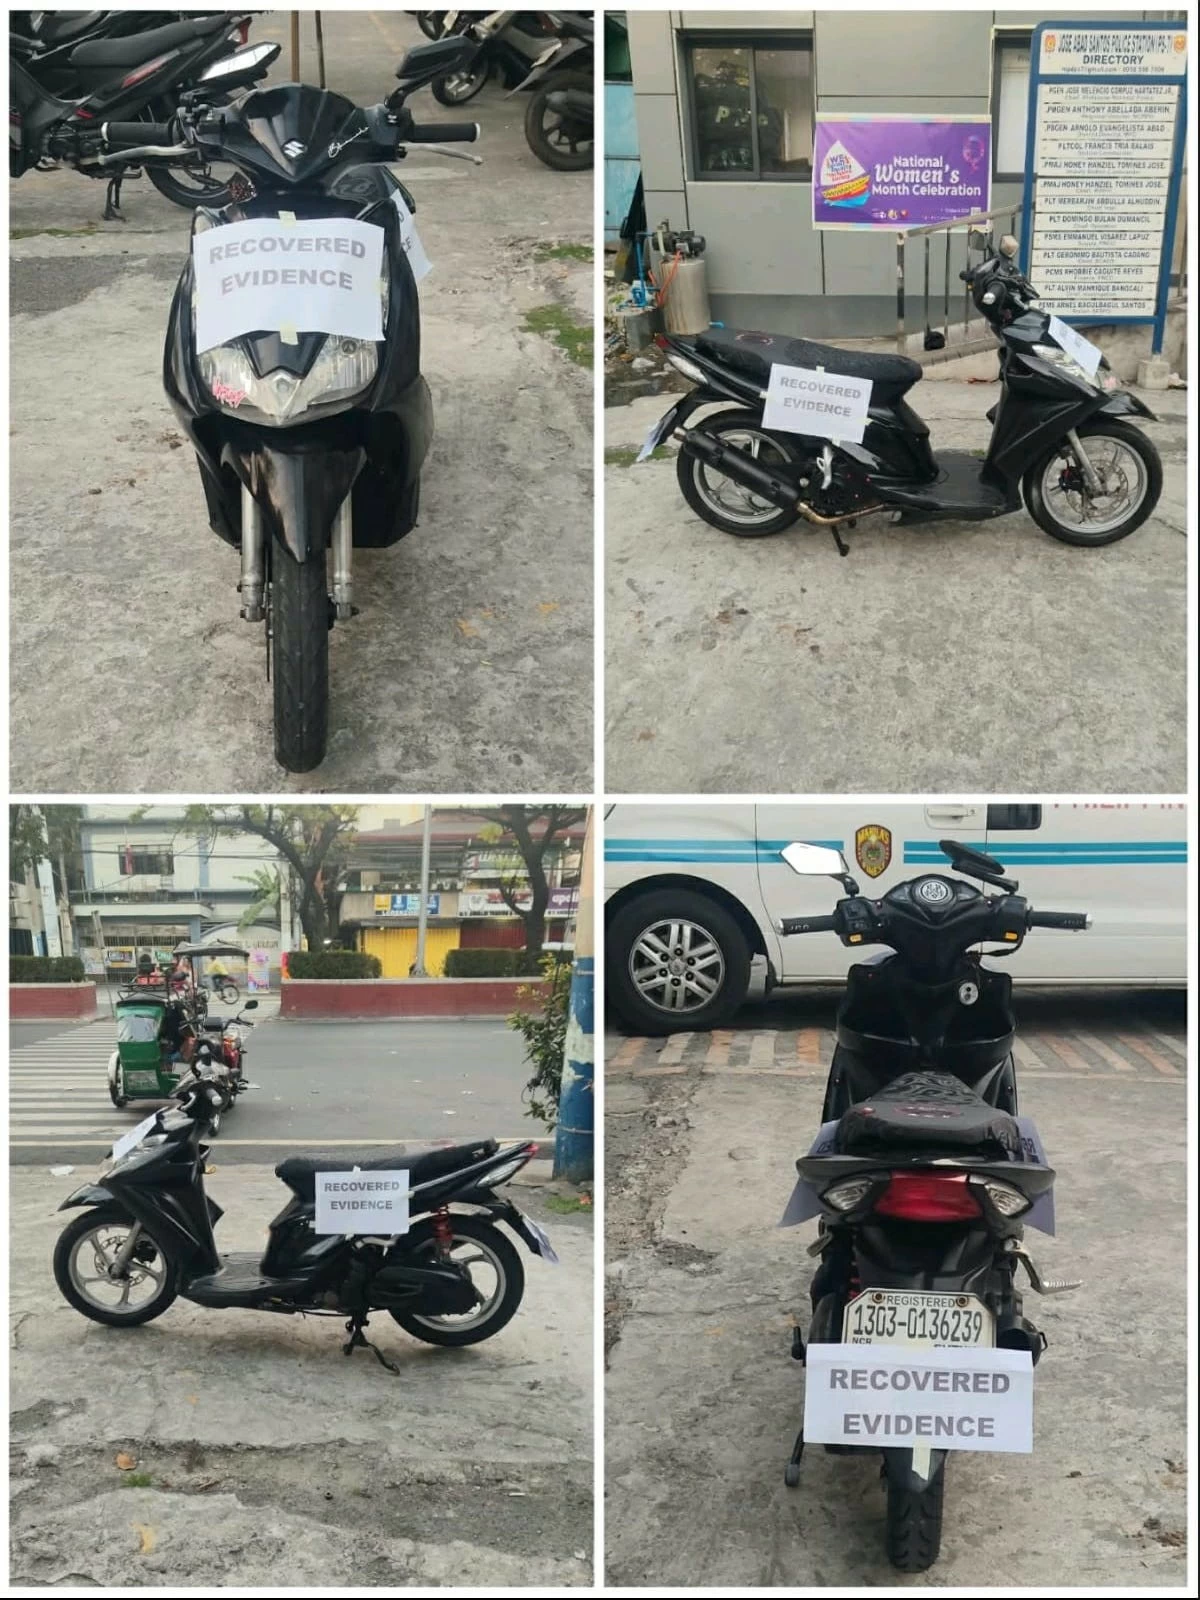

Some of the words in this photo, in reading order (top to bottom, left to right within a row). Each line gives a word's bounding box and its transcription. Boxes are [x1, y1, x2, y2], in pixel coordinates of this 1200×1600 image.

[1058, 35, 1072, 53] JOSE
[1073, 35, 1087, 53] ABAD
[1089, 35, 1110, 53] SANTOS
[1112, 35, 1130, 53] POLICE
[1083, 55, 1144, 64] DIRECTORY
[1070, 124, 1097, 132] ARNOLD
[1100, 124, 1144, 132] EVANGELISTA
[893, 156, 943, 168] National
[874, 163, 960, 184] Women's
[872, 184, 910, 196] Month
[912, 184, 981, 196] Celebration
[210, 237, 366, 264] RECOVERED
[221, 269, 353, 295] EVIDENCE
[780, 376, 861, 399] RECOVERED
[784, 397, 852, 417] EVIDENCE
[324, 1182, 400, 1192] RECOVERED
[330, 1200, 393, 1210] EVIDENCE
[887, 1295, 956, 1308] REGISTERED
[853, 1304, 983, 1343] 1303-0136239
[830, 1368, 1010, 1394] RECOVERED
[843, 1413, 995, 1438] EVIDENCE
